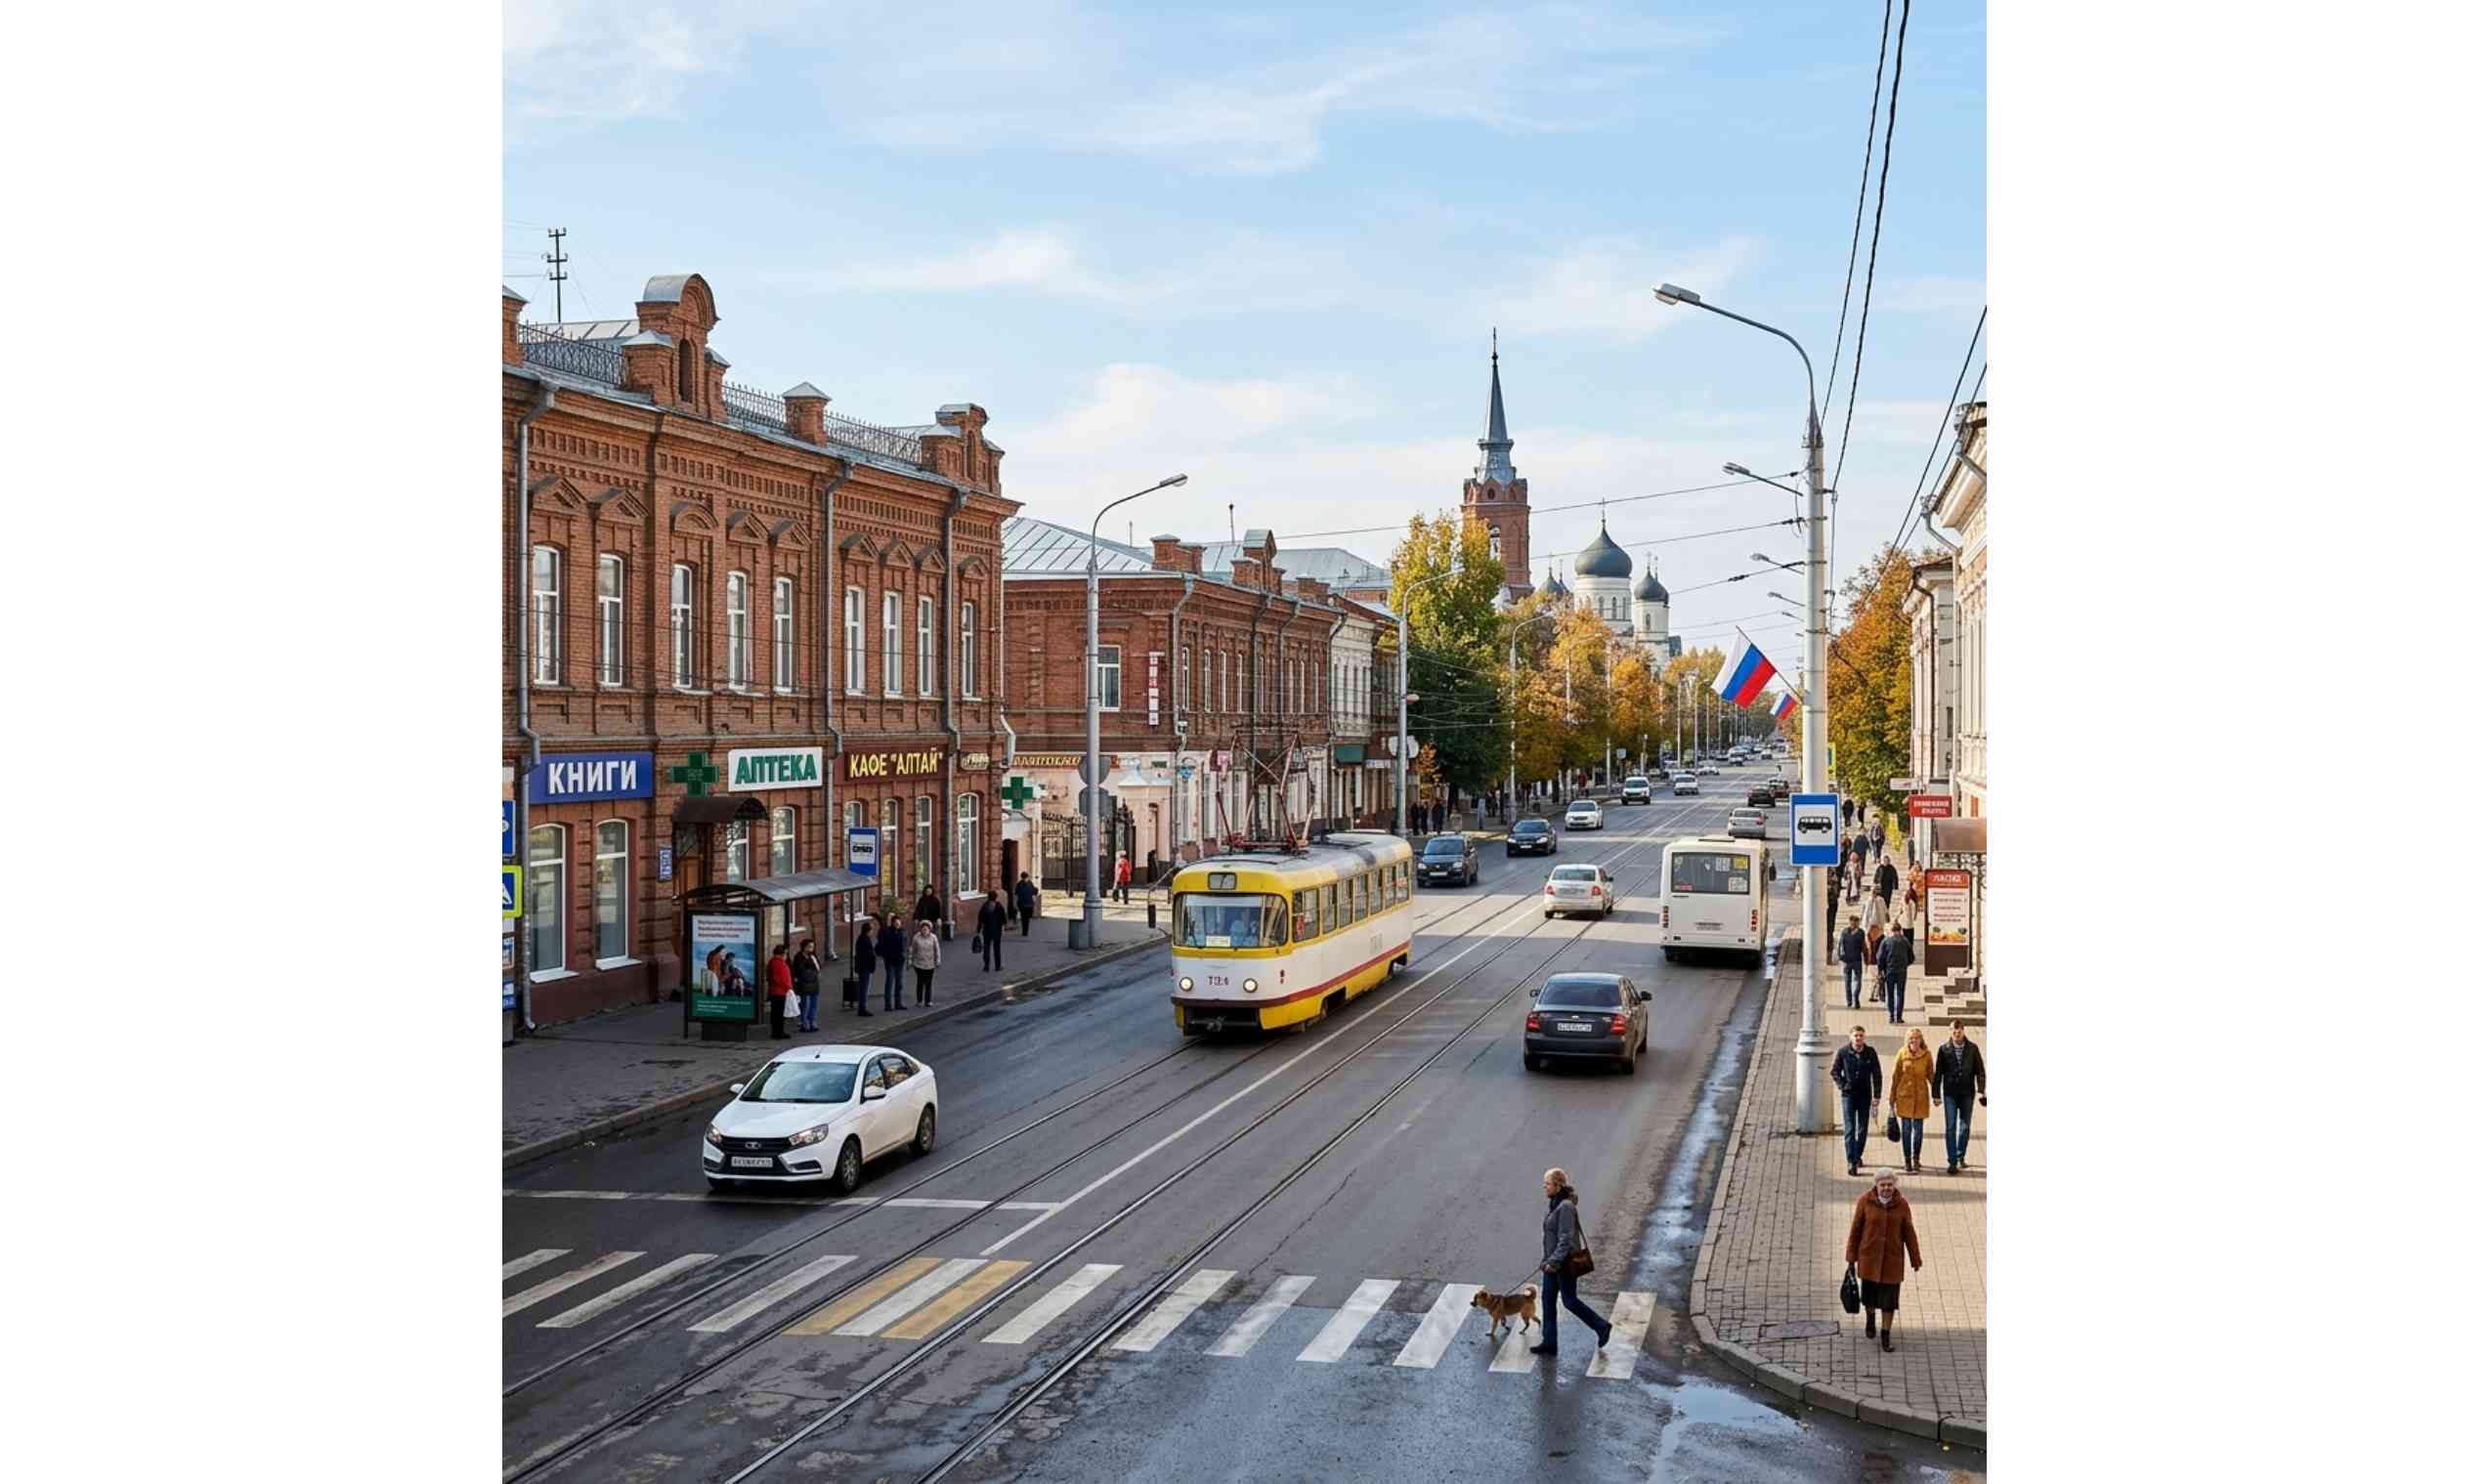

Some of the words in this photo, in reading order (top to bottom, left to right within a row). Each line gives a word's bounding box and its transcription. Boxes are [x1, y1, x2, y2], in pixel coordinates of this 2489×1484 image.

[548, 760, 637, 794] КНИГИ
[735, 753, 817, 784] АПТЕКА
[850, 753, 887, 779] КАФЕ
[890, 746, 943, 775] "АЛТАЙ"
